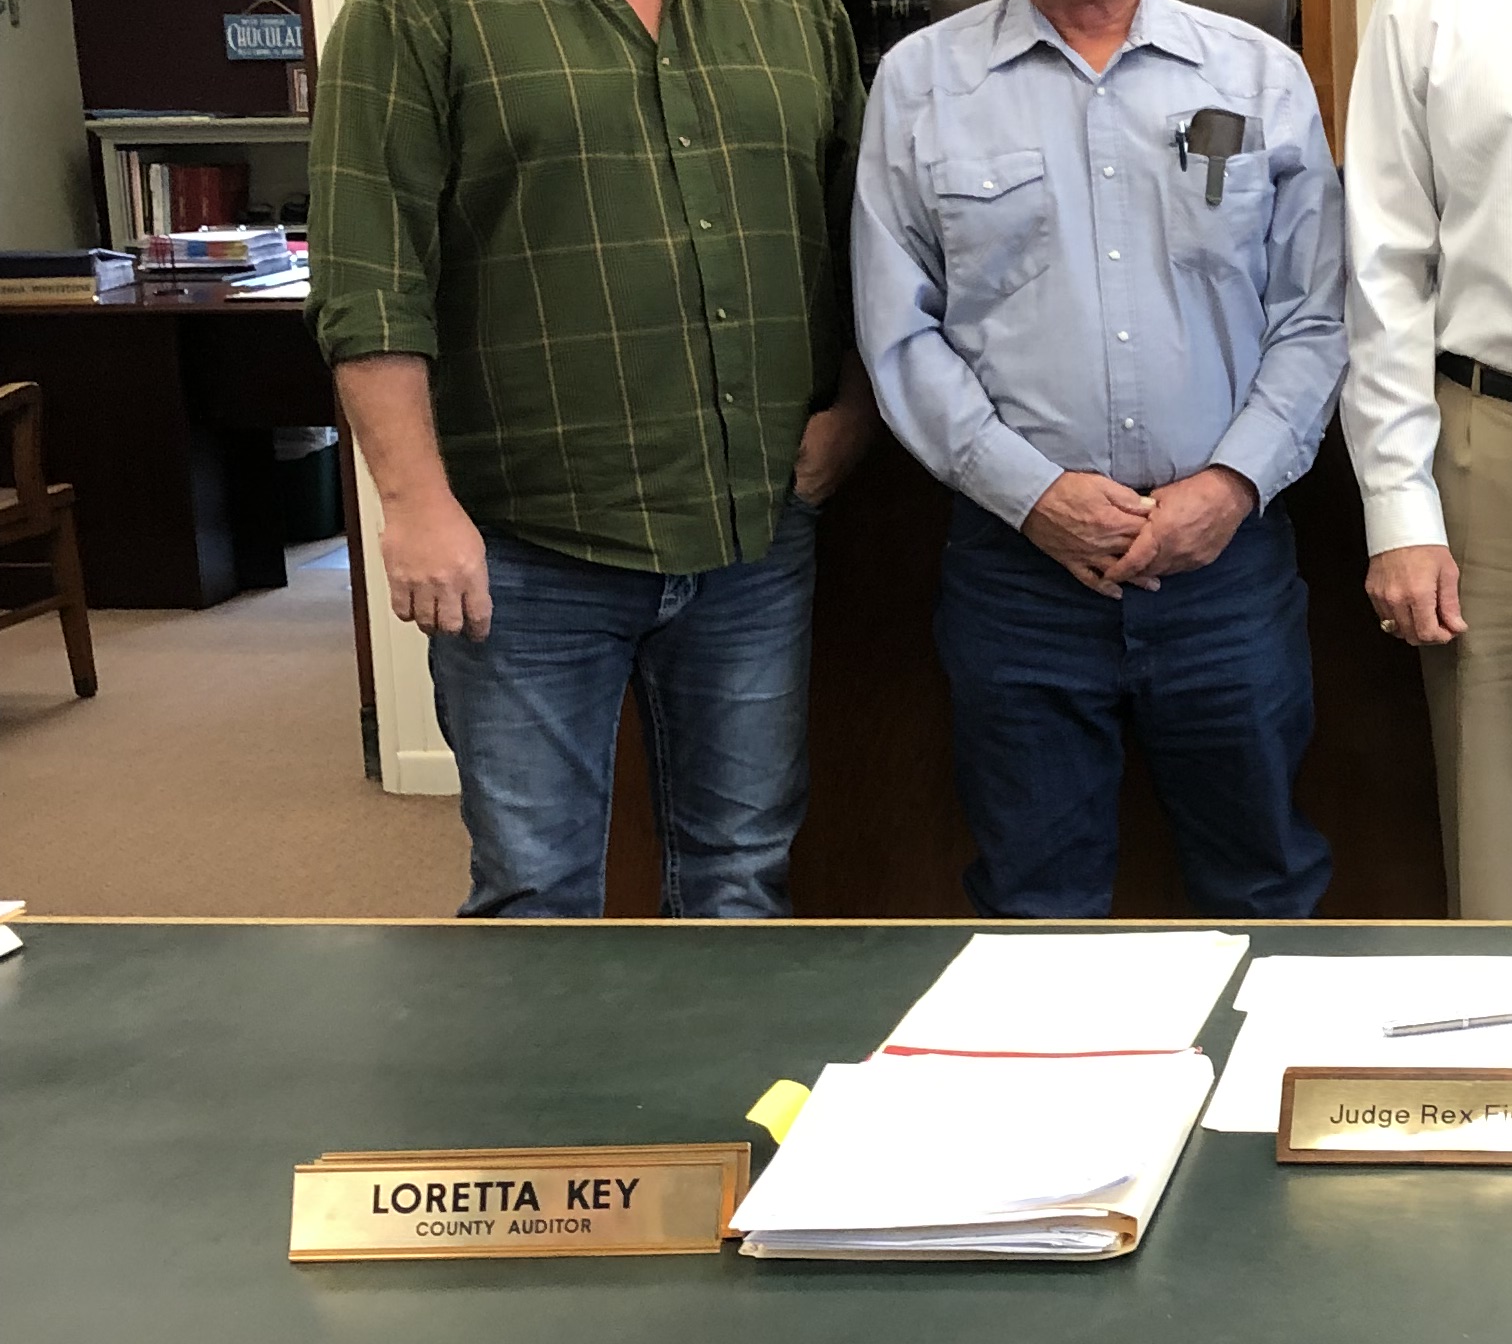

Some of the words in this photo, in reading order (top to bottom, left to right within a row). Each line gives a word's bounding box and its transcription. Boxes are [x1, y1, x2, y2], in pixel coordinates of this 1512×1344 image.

[1329, 1104, 1411, 1128] Judge
[1420, 1104, 1474, 1124] Rex
[372, 1181, 541, 1214] LORETTA
[566, 1177, 641, 1210] KEY
[415, 1219, 496, 1237] COUNTY
[507, 1217, 592, 1235] AUDITOR
